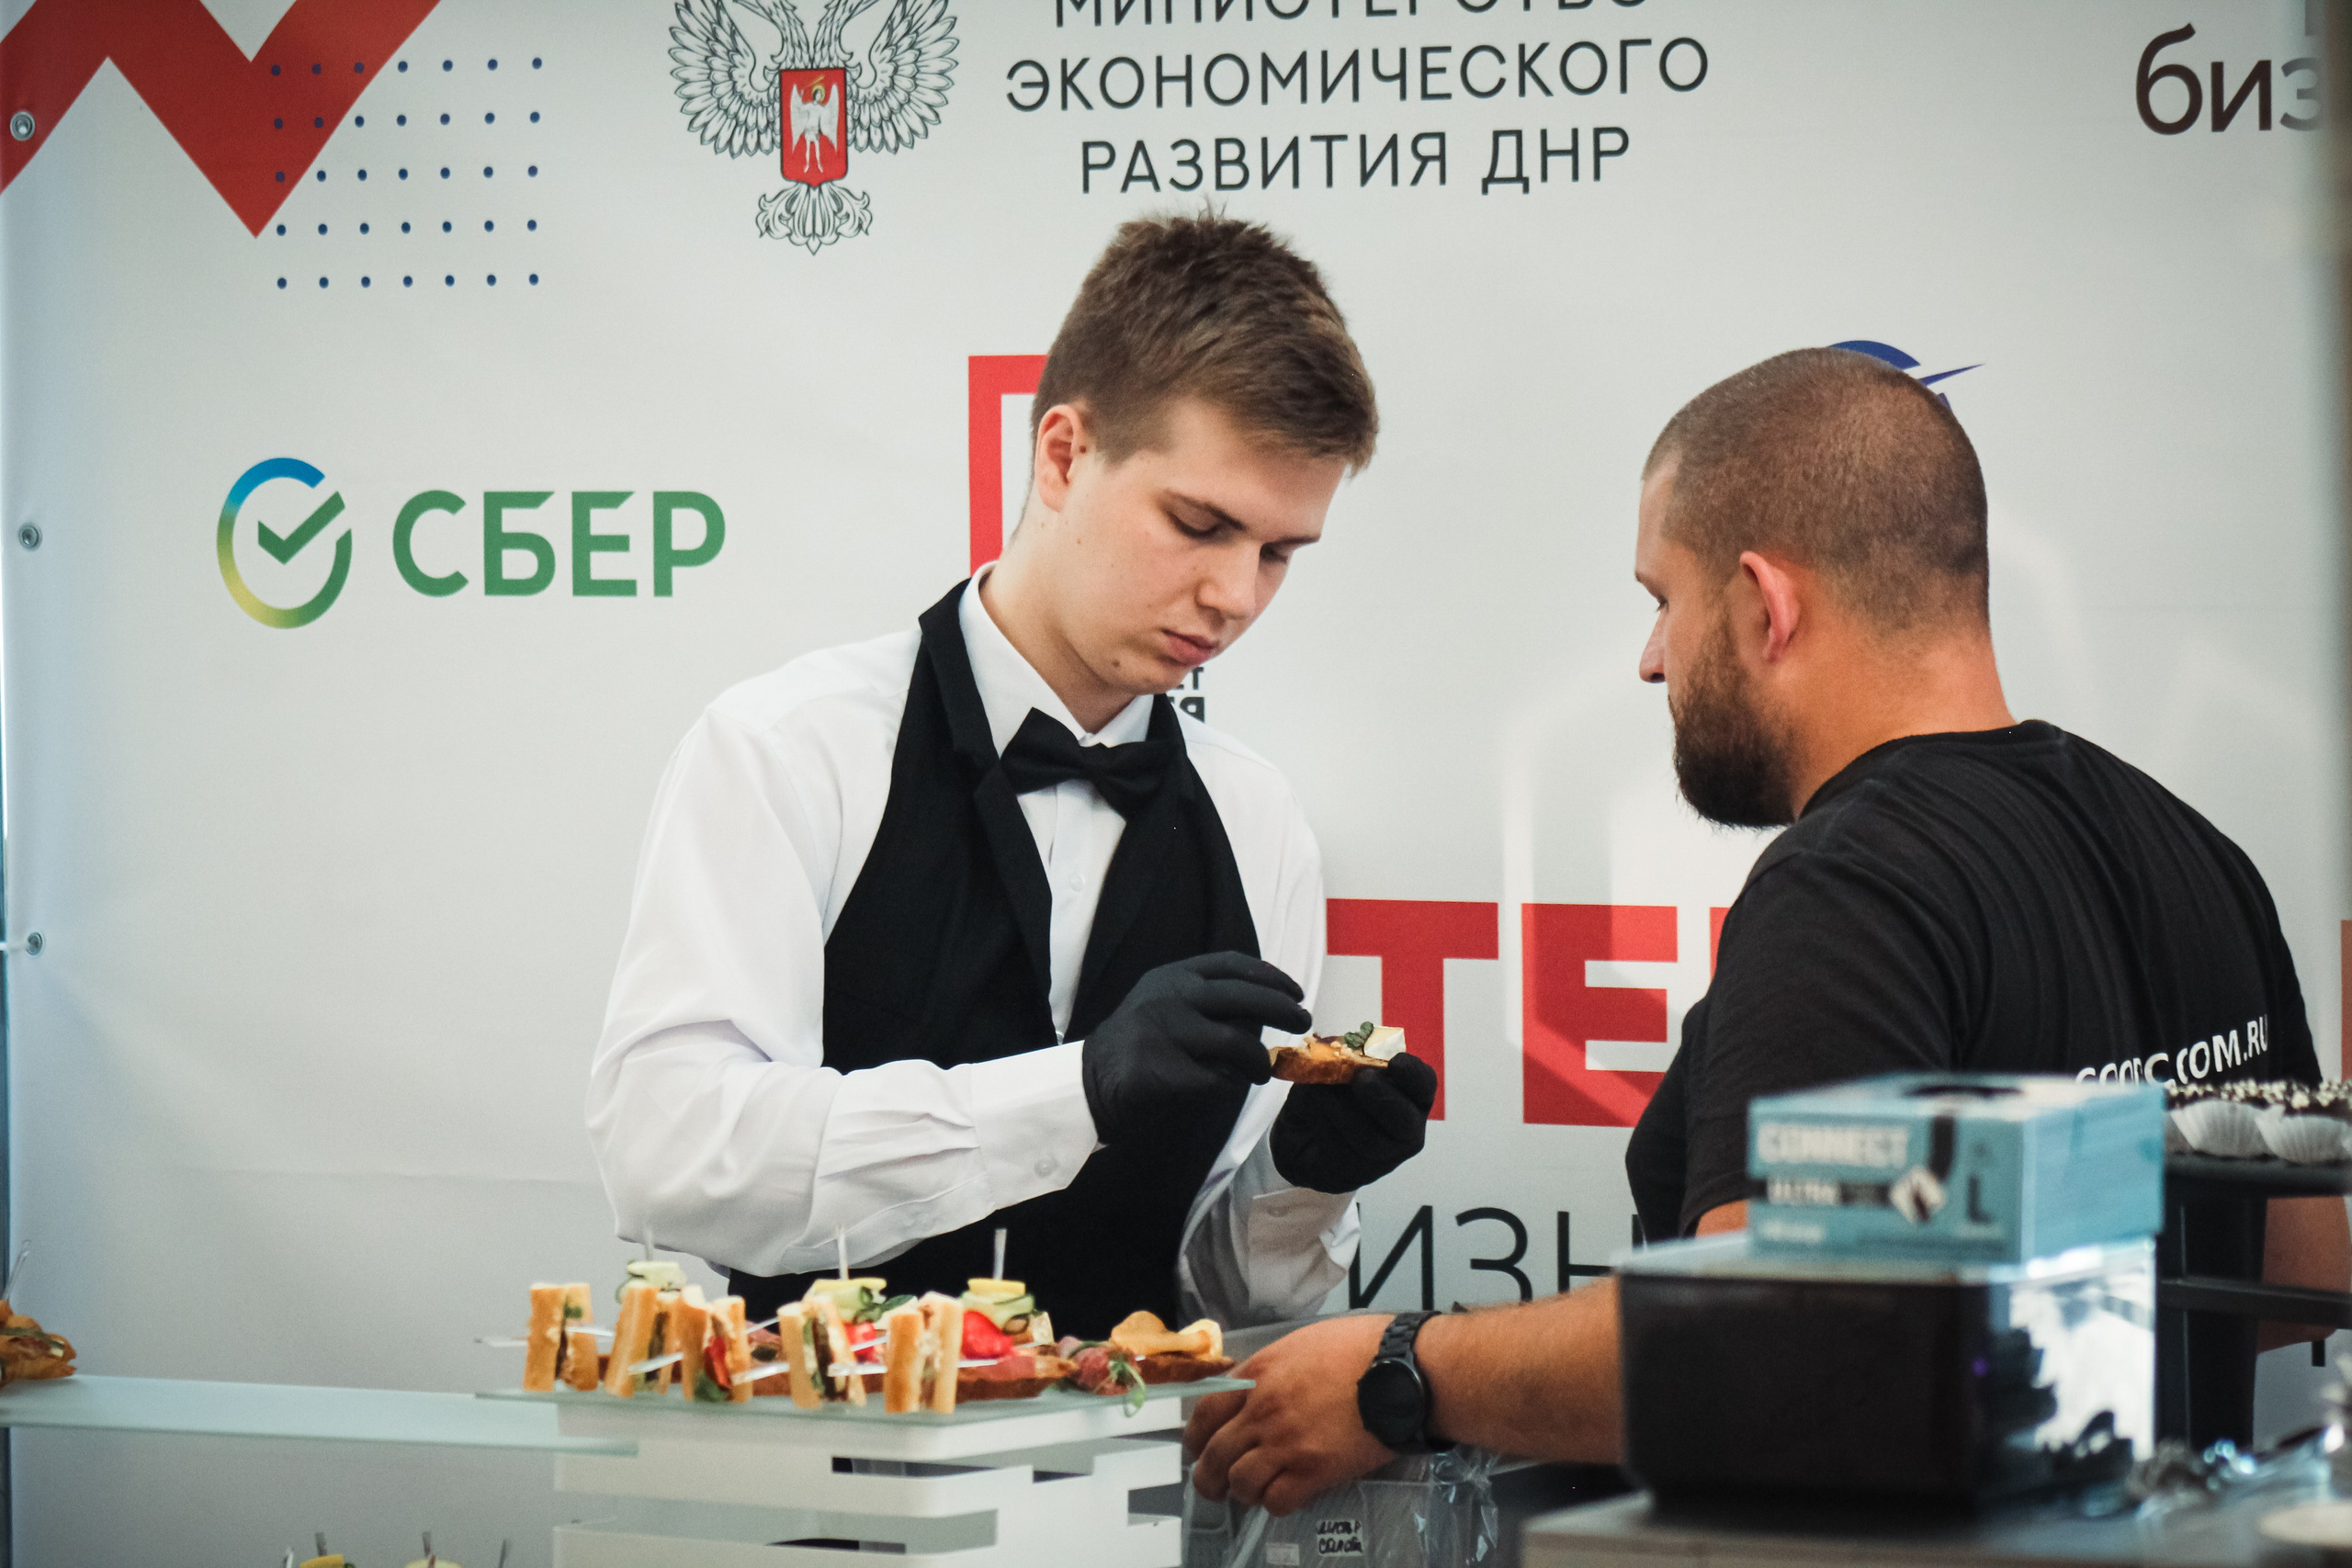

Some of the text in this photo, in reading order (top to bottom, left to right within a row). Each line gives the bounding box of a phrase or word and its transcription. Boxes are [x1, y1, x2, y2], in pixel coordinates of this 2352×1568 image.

[1005, 37, 1709, 113] ЭКОНОМИЧЕСКОГО
[1080, 126, 1630, 196] РАЗВИТИЯ ДНР
[392, 490, 727, 598] СБЕР
